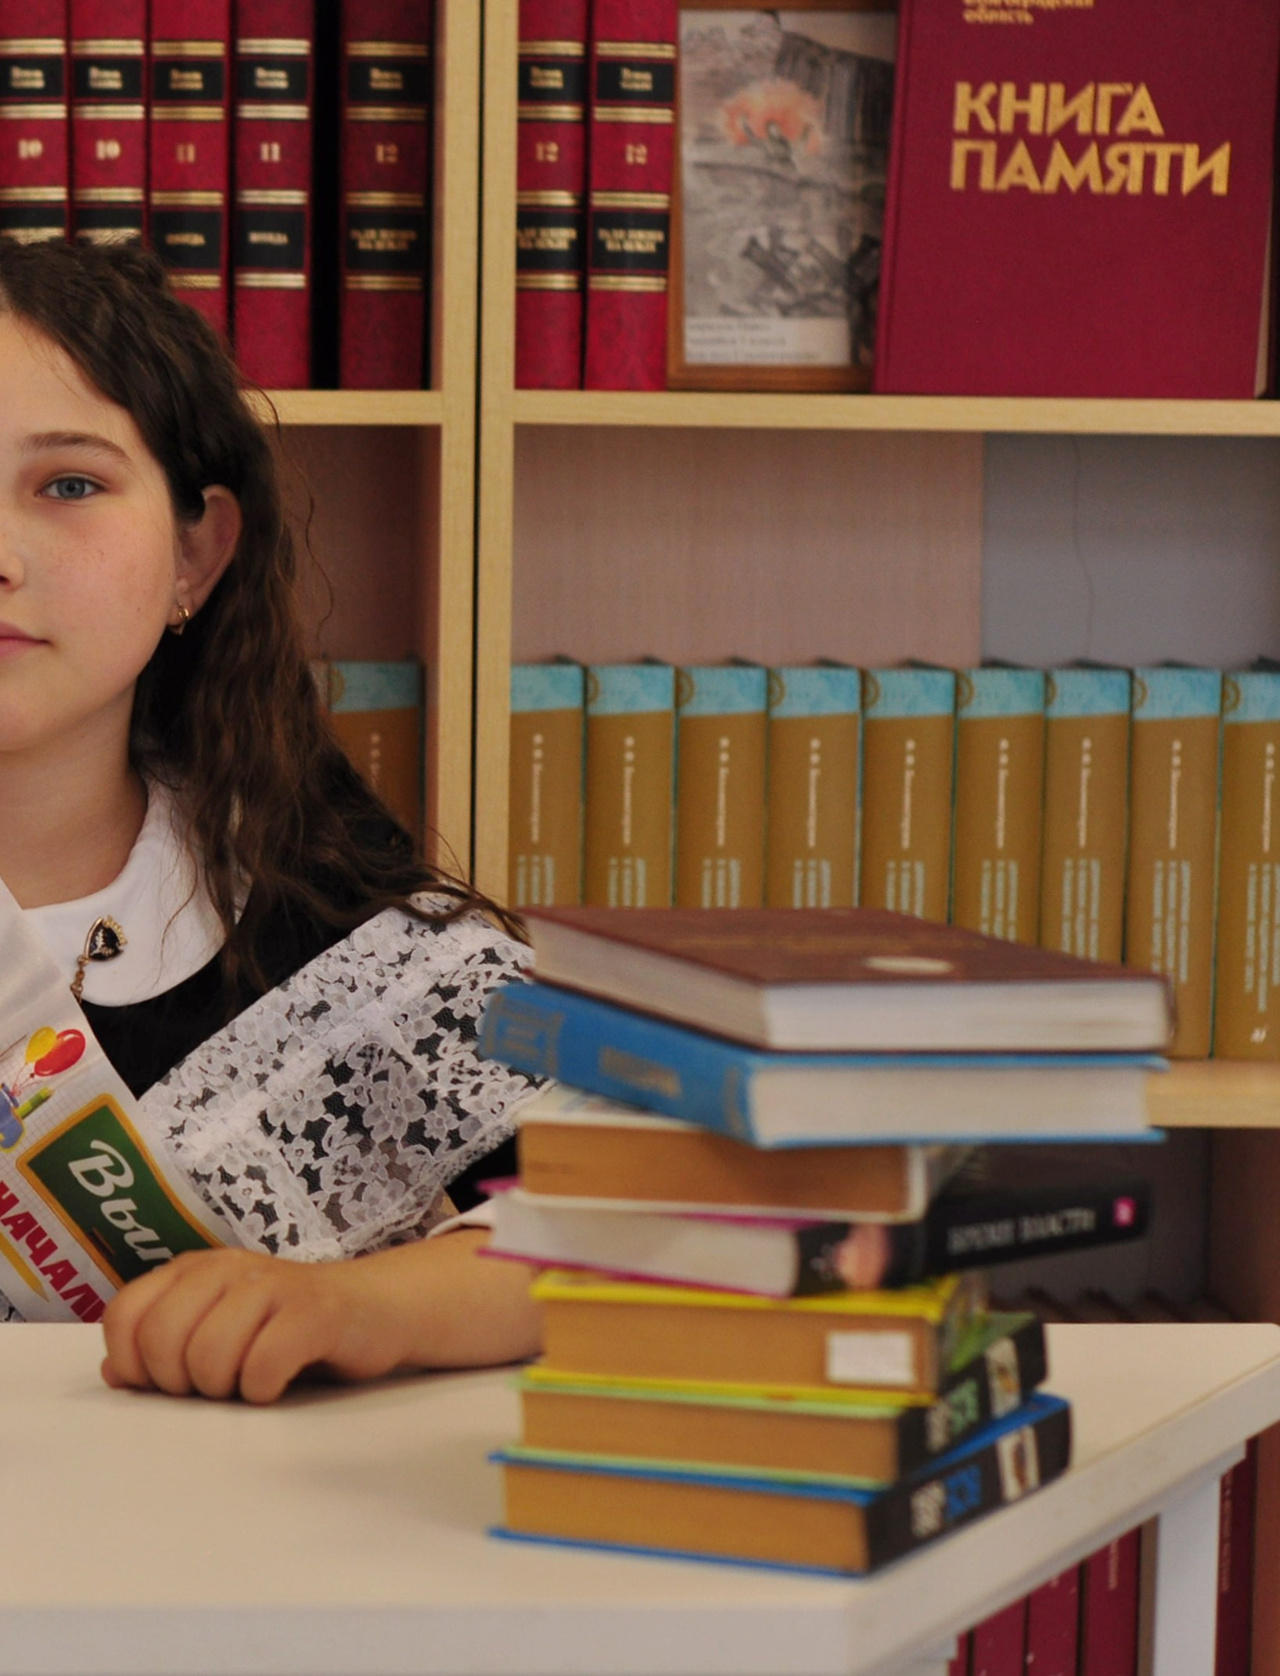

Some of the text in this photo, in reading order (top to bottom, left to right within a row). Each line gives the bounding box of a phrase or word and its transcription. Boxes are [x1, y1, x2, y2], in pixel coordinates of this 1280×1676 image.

[952, 81, 1165, 136] КНИГА
[18, 138, 43, 160] 10
[95, 138, 120, 161] 10
[950, 139, 1231, 196] ПАМЯТИ
